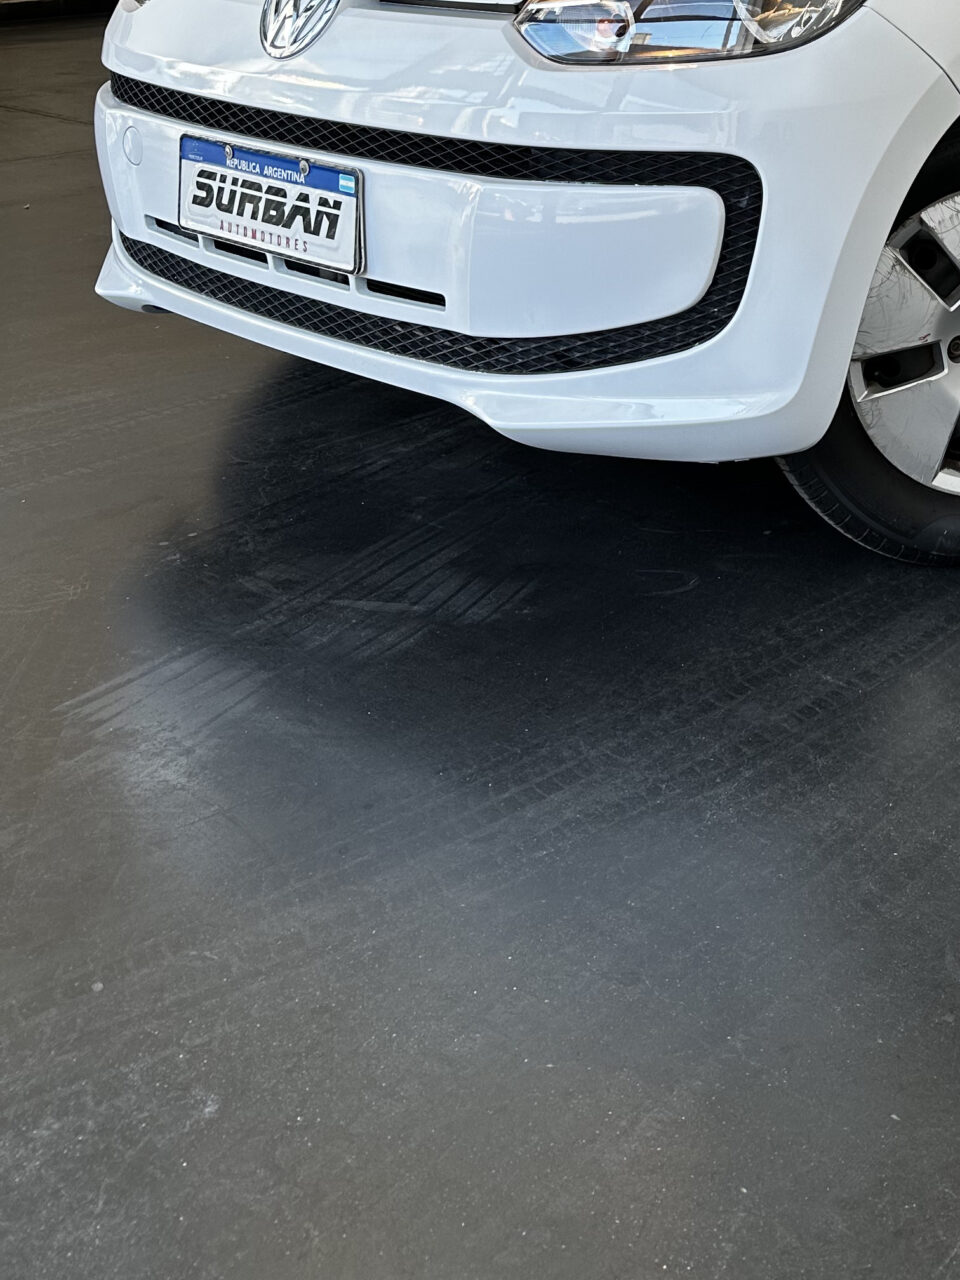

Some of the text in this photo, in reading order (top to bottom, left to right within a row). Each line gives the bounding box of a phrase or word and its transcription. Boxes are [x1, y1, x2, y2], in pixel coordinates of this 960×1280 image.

[263, 165, 305, 183] ARGENTINA
[192, 169, 343, 240] SURBAN
[219, 219, 308, 252] AUTOMOTORES
